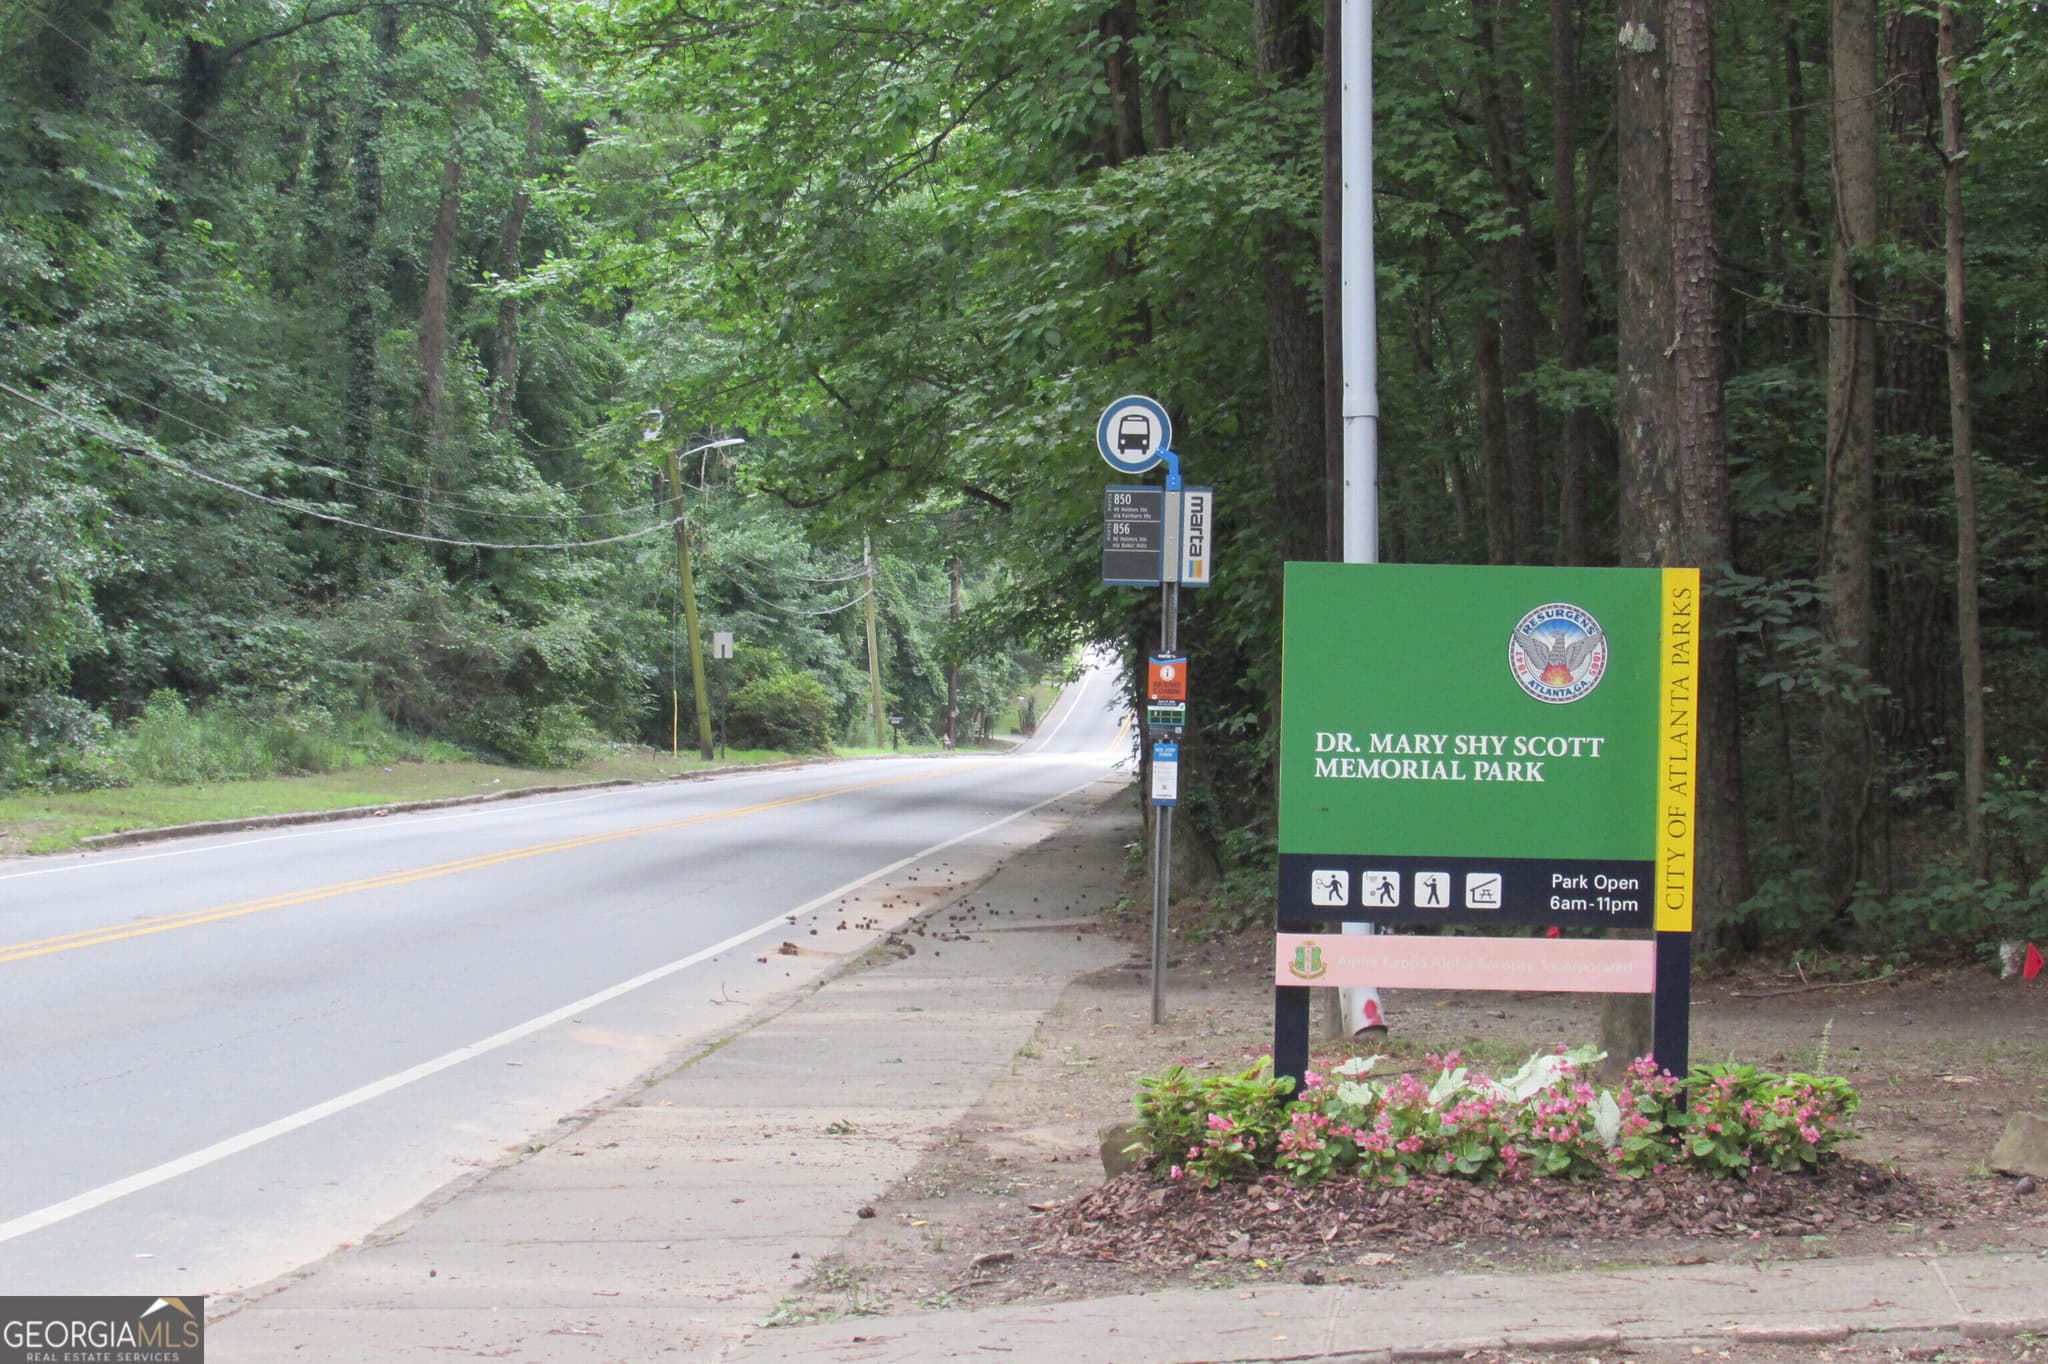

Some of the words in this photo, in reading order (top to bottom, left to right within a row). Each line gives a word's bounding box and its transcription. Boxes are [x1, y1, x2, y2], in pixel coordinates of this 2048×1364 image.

[1113, 493, 1132, 506] 850
[1112, 523, 1130, 535] 856
[1190, 496, 1204, 557] marta
[1522, 609, 1596, 635] RESURGENS
[1672, 588, 1692, 666] PARKS
[1515, 651, 1528, 675] 1847
[1589, 651, 1601, 676] 1865
[1315, 732, 1361, 753] DR.
[1370, 733, 1448, 755] MARY
[1454, 735, 1508, 756] SHY
[1513, 736, 1604, 758] SCOTT
[1669, 676, 1689, 796] ATLANTA
[1314, 757, 1466, 780] MEMORIAL
[1474, 760, 1545, 782] PARK
[1667, 806, 1687, 838] OF
[1552, 873, 1588, 889] Park
[1594, 874, 1639, 893] Open
[1665, 848, 1686, 910] CITY
